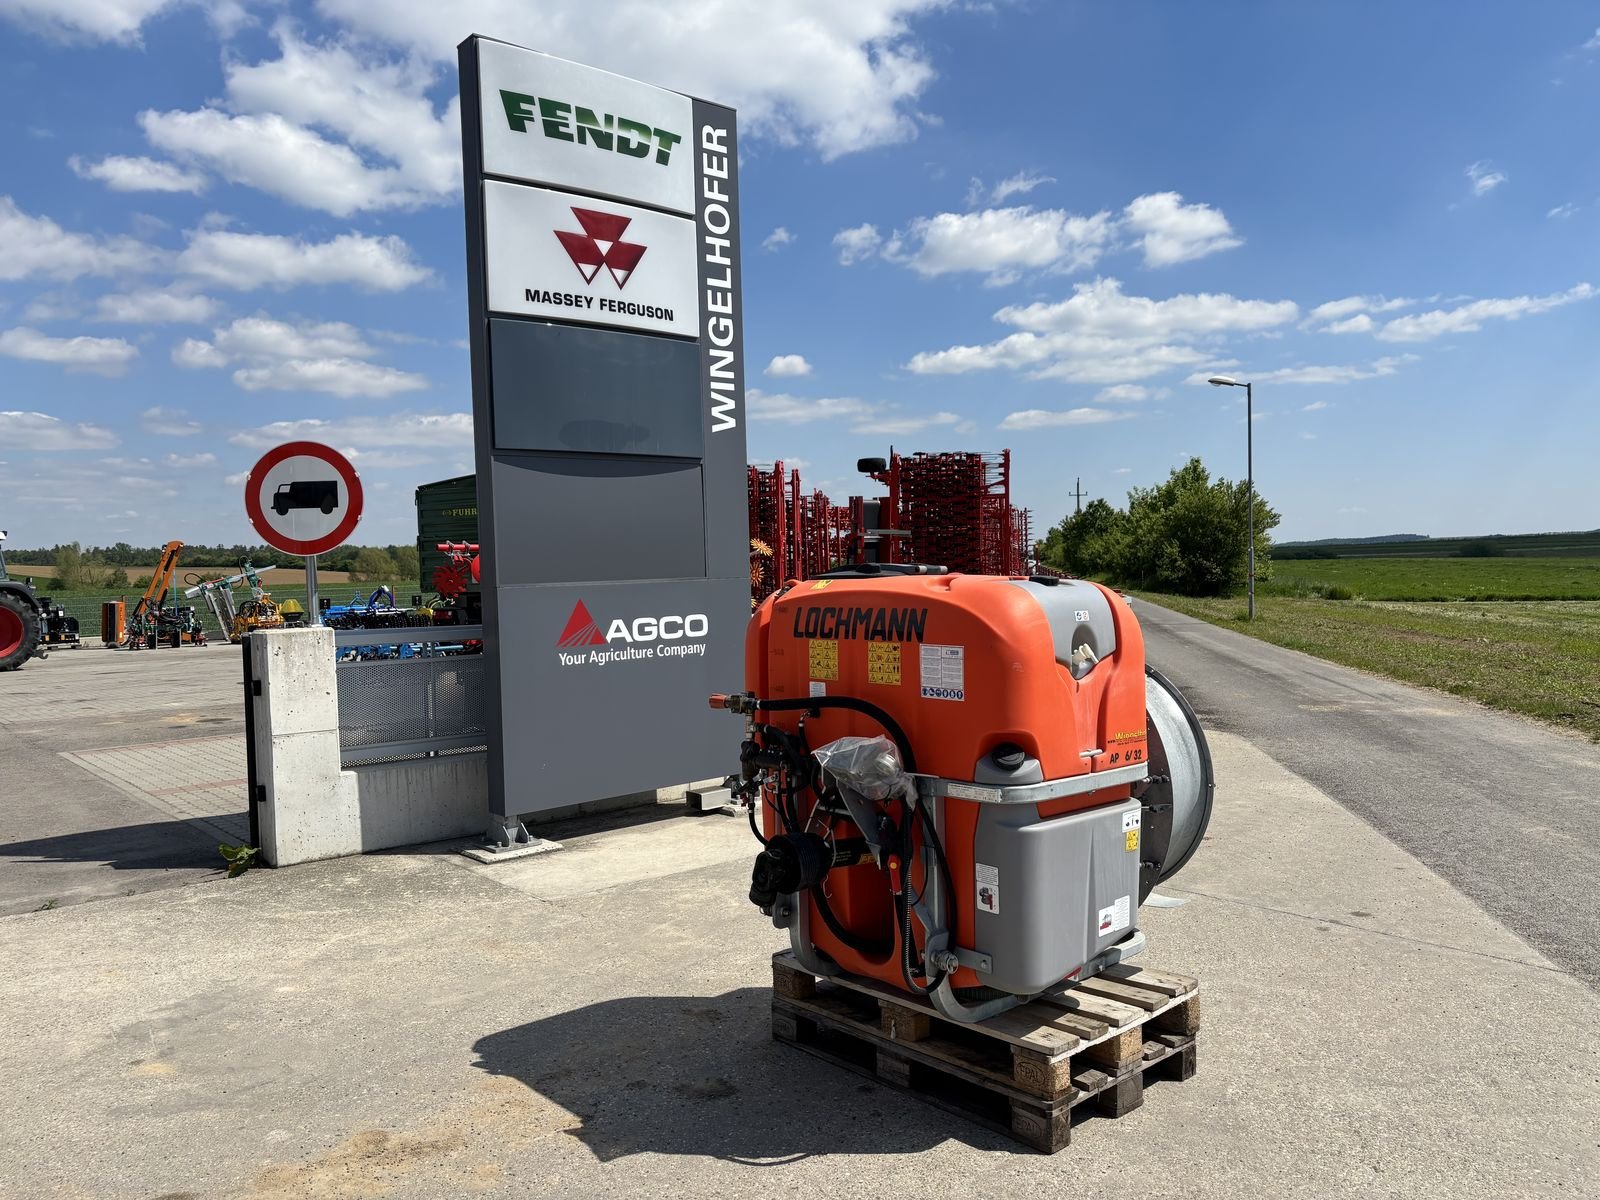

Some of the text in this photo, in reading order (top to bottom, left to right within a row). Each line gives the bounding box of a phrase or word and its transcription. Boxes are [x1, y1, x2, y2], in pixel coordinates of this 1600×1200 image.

[499, 89, 682, 166] FENDT
[702, 125, 736, 432] WINGELHOFER
[525, 289, 674, 321] MASSEY FERGUSON
[605, 613, 709, 644] AGCO
[793, 607, 928, 642] LOCHMANN
[558, 642, 706, 666] Your Agriculture Company
[1110, 749, 1142, 764] AP 6/32
